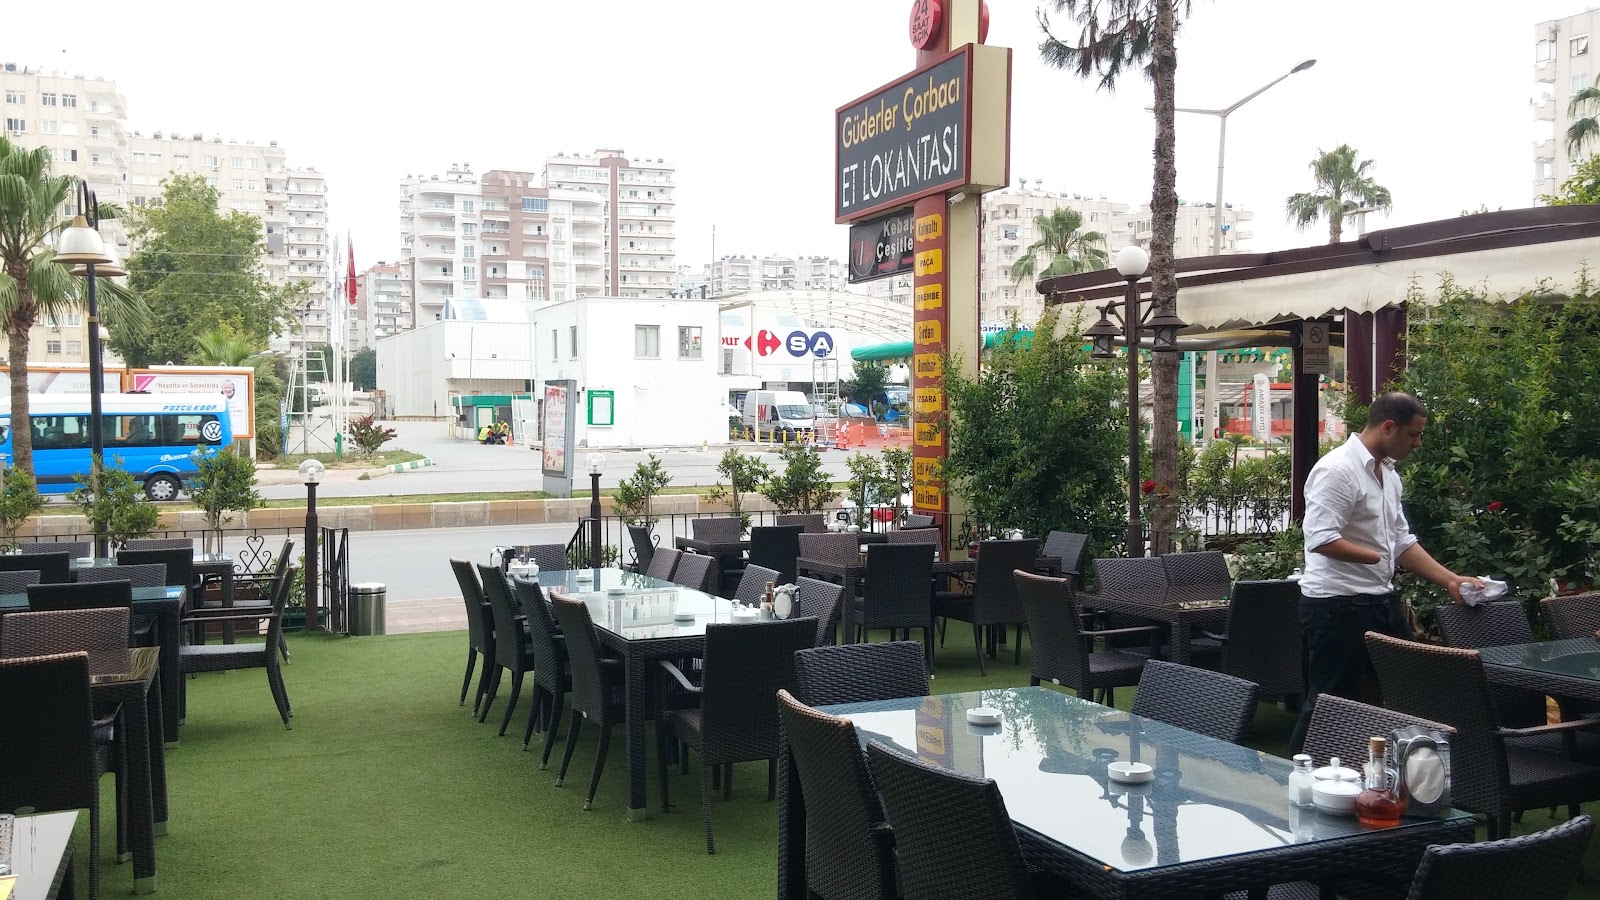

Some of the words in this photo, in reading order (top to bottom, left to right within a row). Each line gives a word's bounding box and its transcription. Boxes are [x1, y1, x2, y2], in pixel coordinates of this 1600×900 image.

[914, 0, 929, 22] 24
[912, 16, 930, 34] SAAT
[912, 27, 929, 45] AÇIK
[842, 99, 898, 149] Güderler
[903, 76, 960, 131] Çorbacı
[842, 163, 858, 208] ET
[863, 123, 958, 202] LOKANTASI
[883, 217, 914, 238] Kebap
[919, 257, 934, 268] PAÇA
[789, 335, 831, 353] SA
